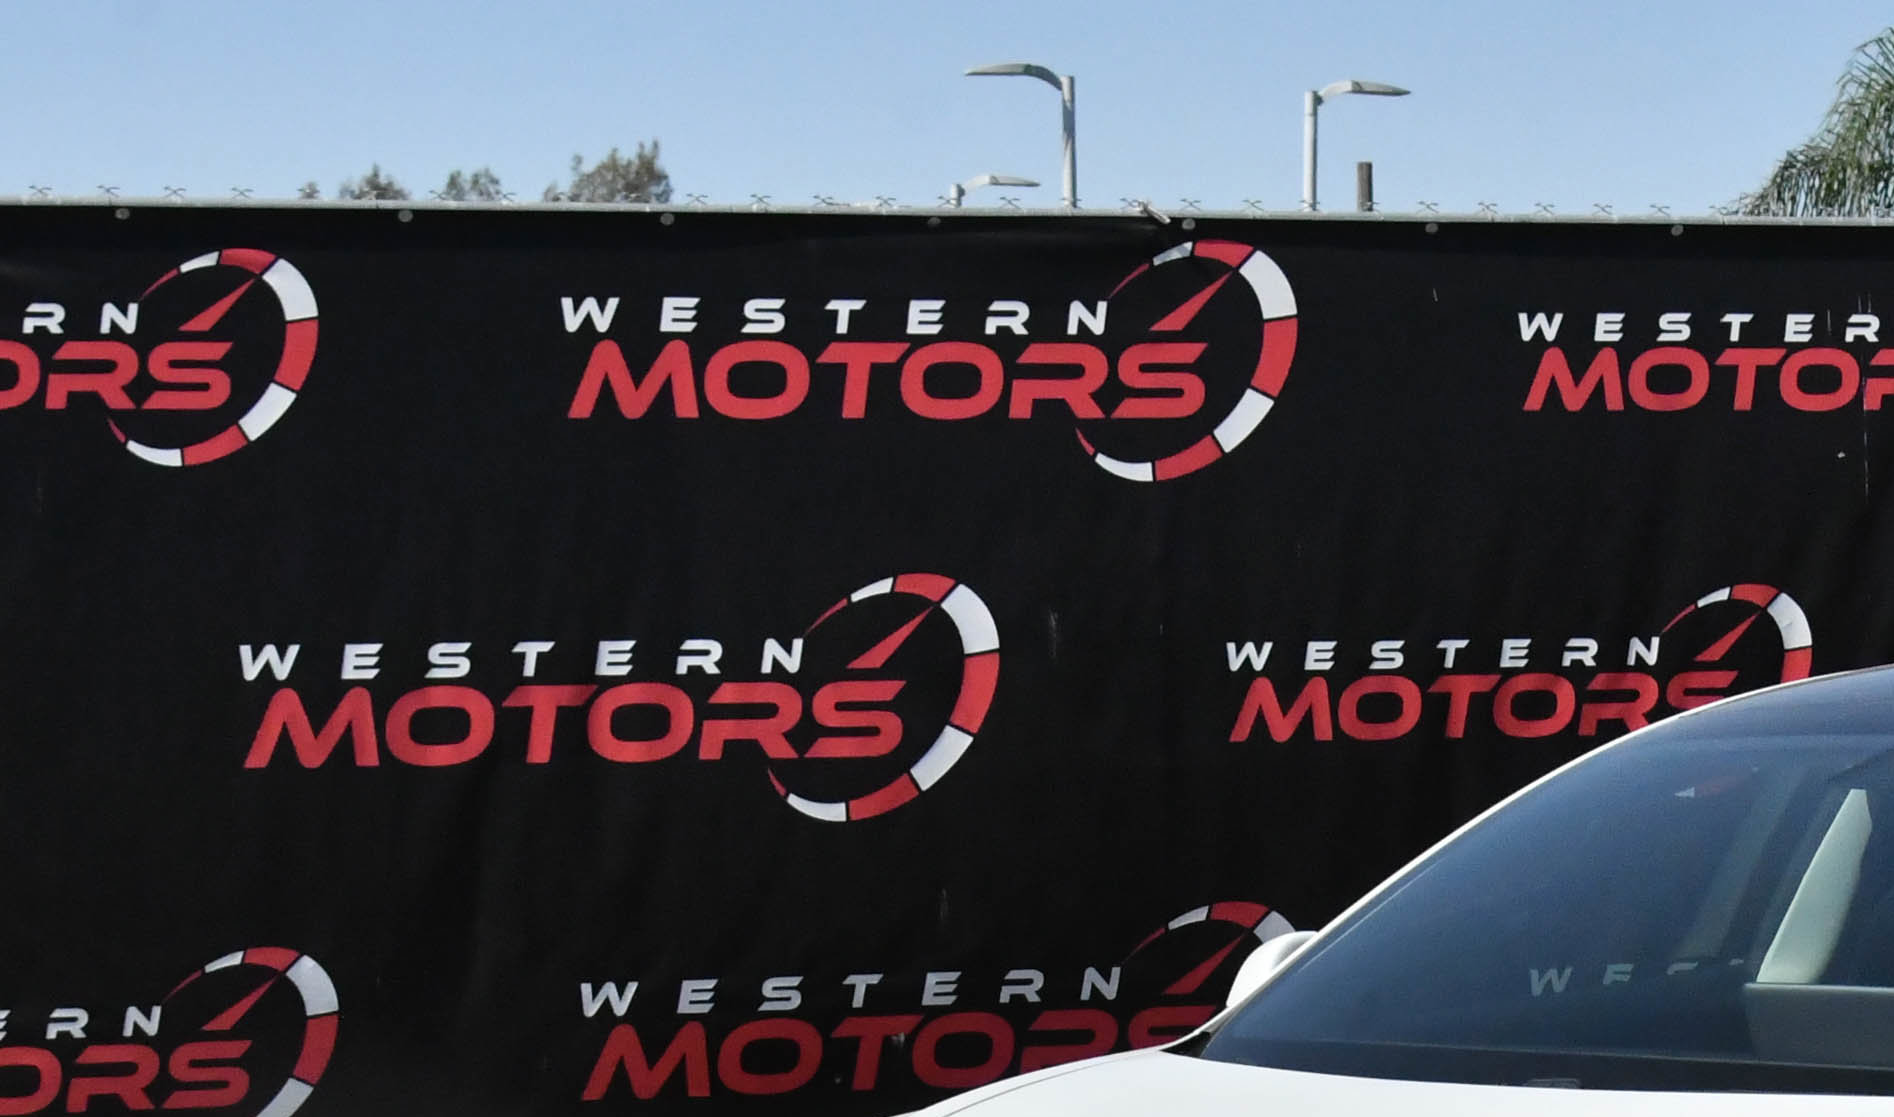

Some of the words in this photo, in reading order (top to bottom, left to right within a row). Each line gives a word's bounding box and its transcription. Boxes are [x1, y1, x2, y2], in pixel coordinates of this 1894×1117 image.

[560, 296, 1108, 336] WESTERN
[567, 338, 1209, 421] MOTORS
[239, 637, 804, 682] WESTERN
[1226, 636, 1660, 672] WESTERN
[244, 679, 907, 769] MOTORS
[580, 966, 1121, 1018] WESTERN
